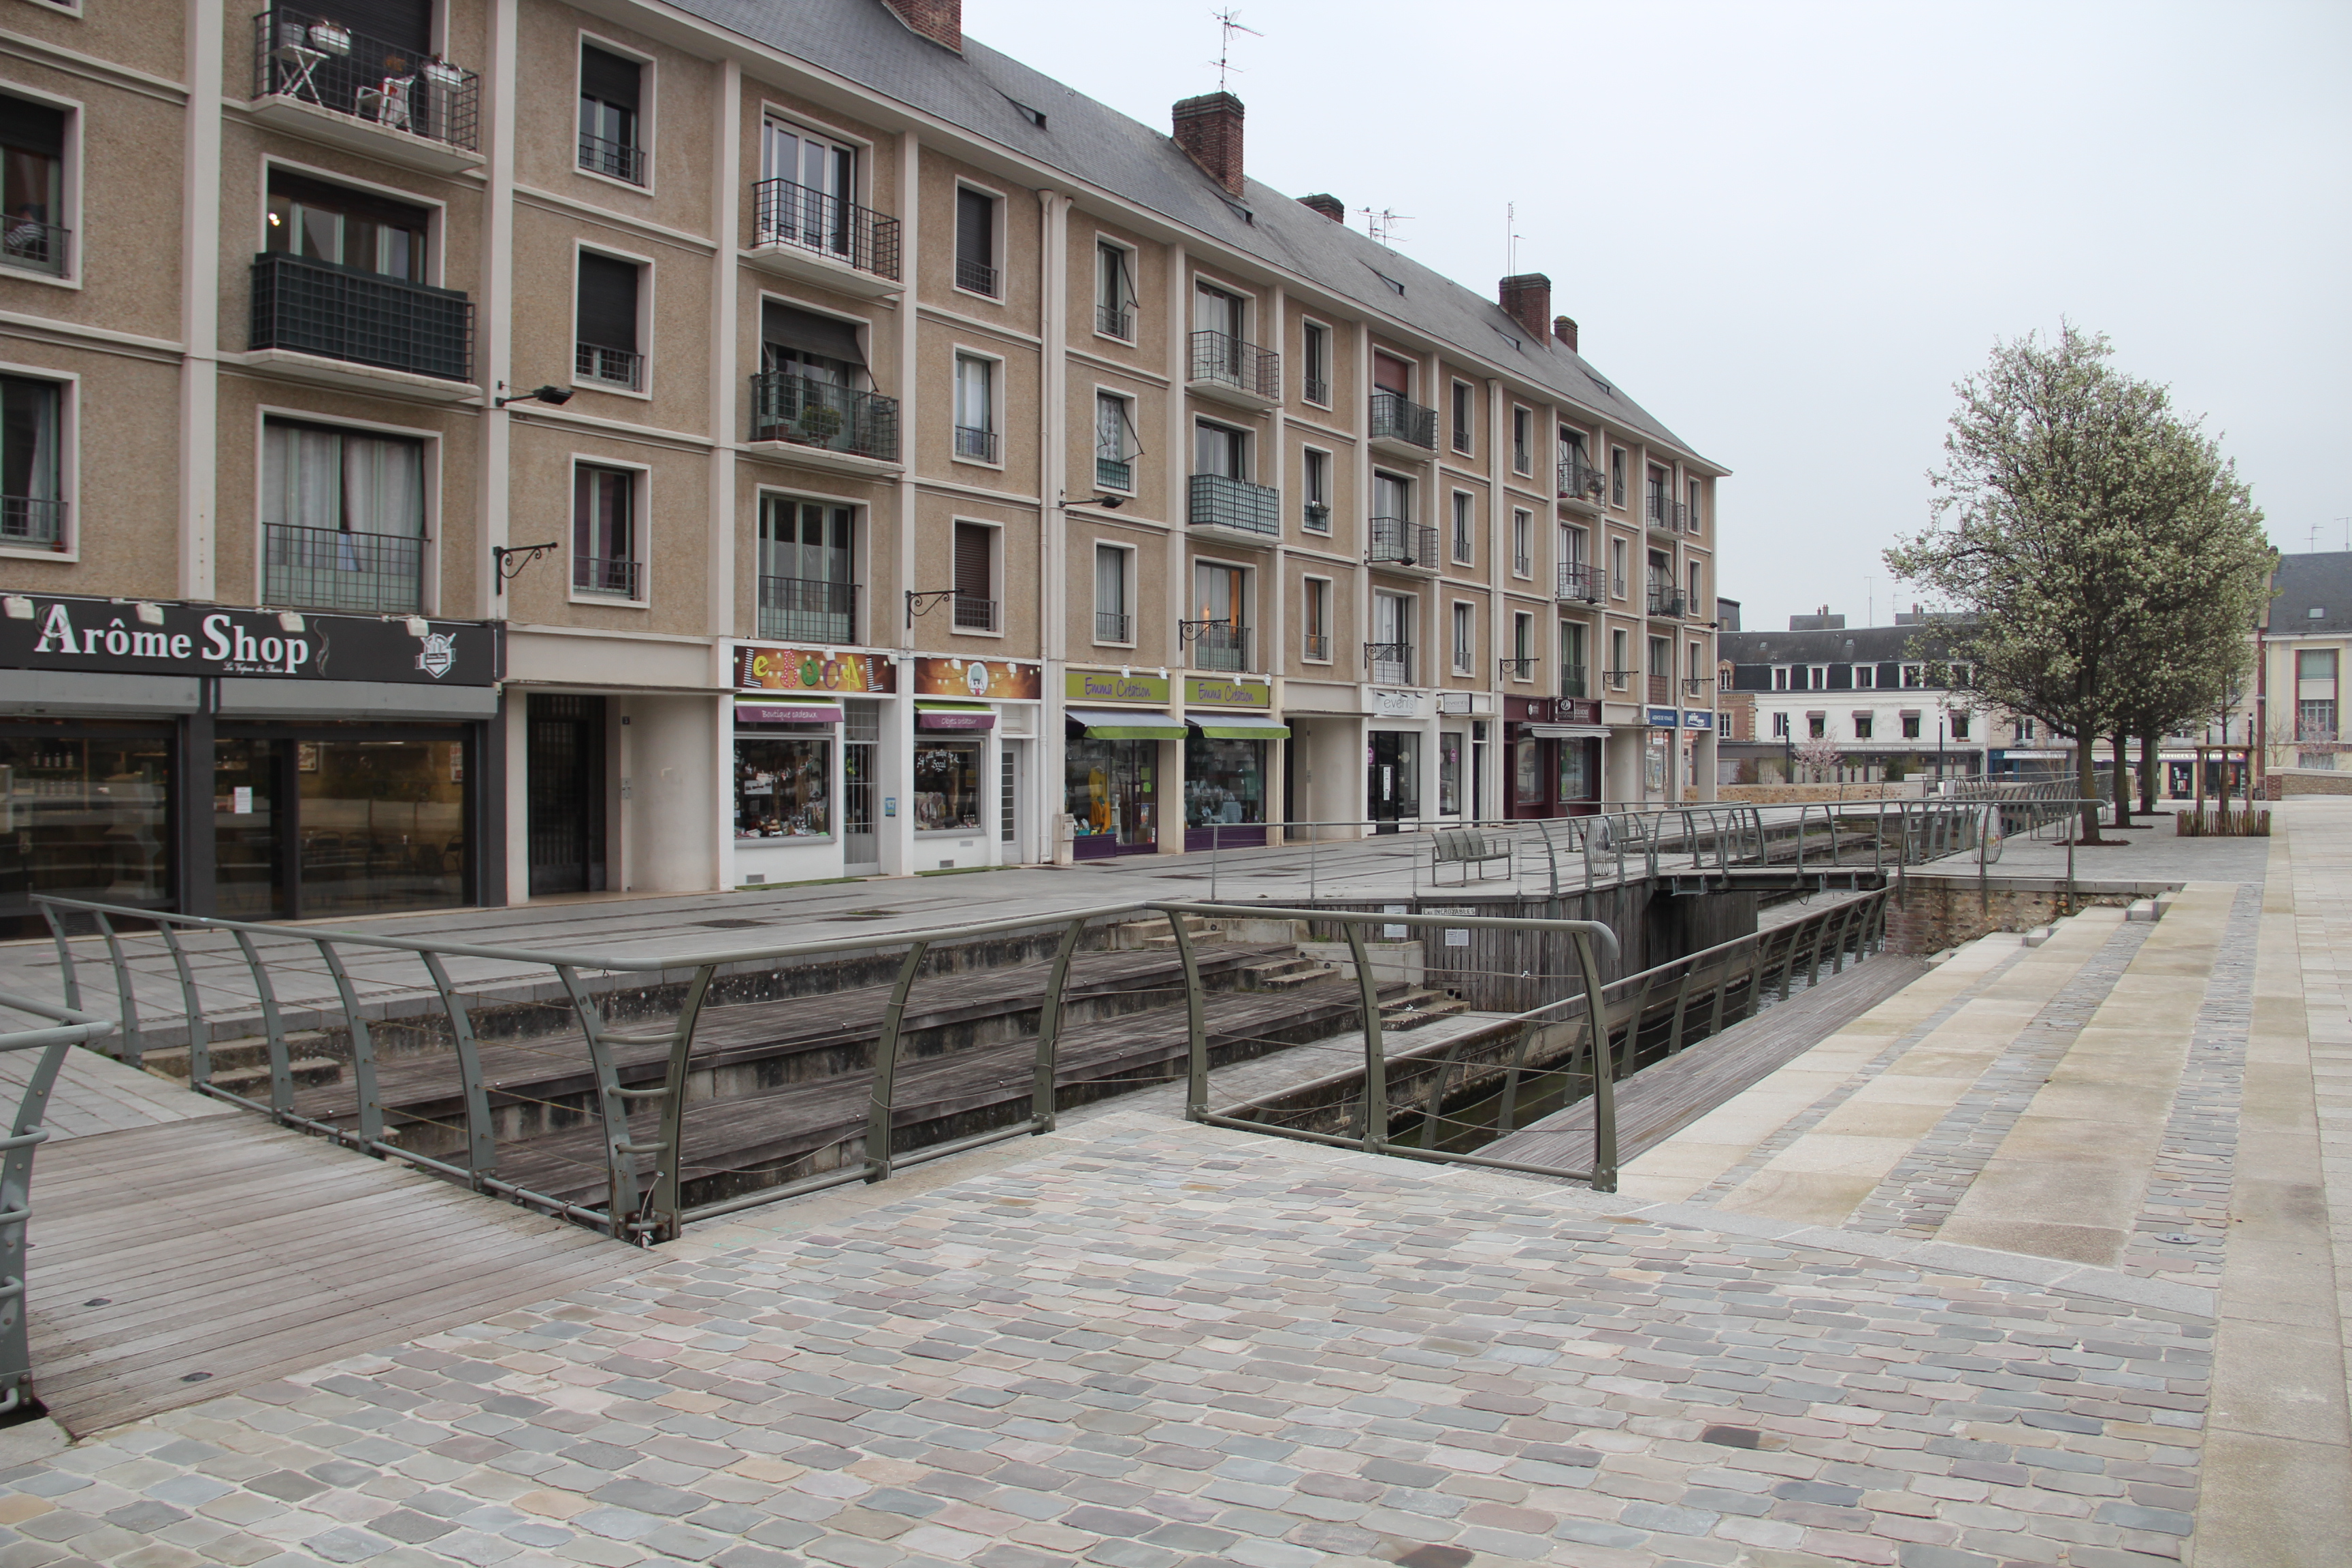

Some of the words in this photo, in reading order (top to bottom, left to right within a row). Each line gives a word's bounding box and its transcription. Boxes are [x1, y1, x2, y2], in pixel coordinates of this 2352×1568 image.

[34, 604, 193, 659] Arôme
[202, 614, 309, 674] Shop
[780, 649, 884, 692] BOCAL
[1085, 676, 1113, 696] Emma
[1117, 679, 1151, 698] Création
[1198, 683, 1222, 700] Emma
[1225, 685, 1254, 702] Création
[762, 709, 791, 720] Boutique
[791, 710, 818, 718] cadeaux
